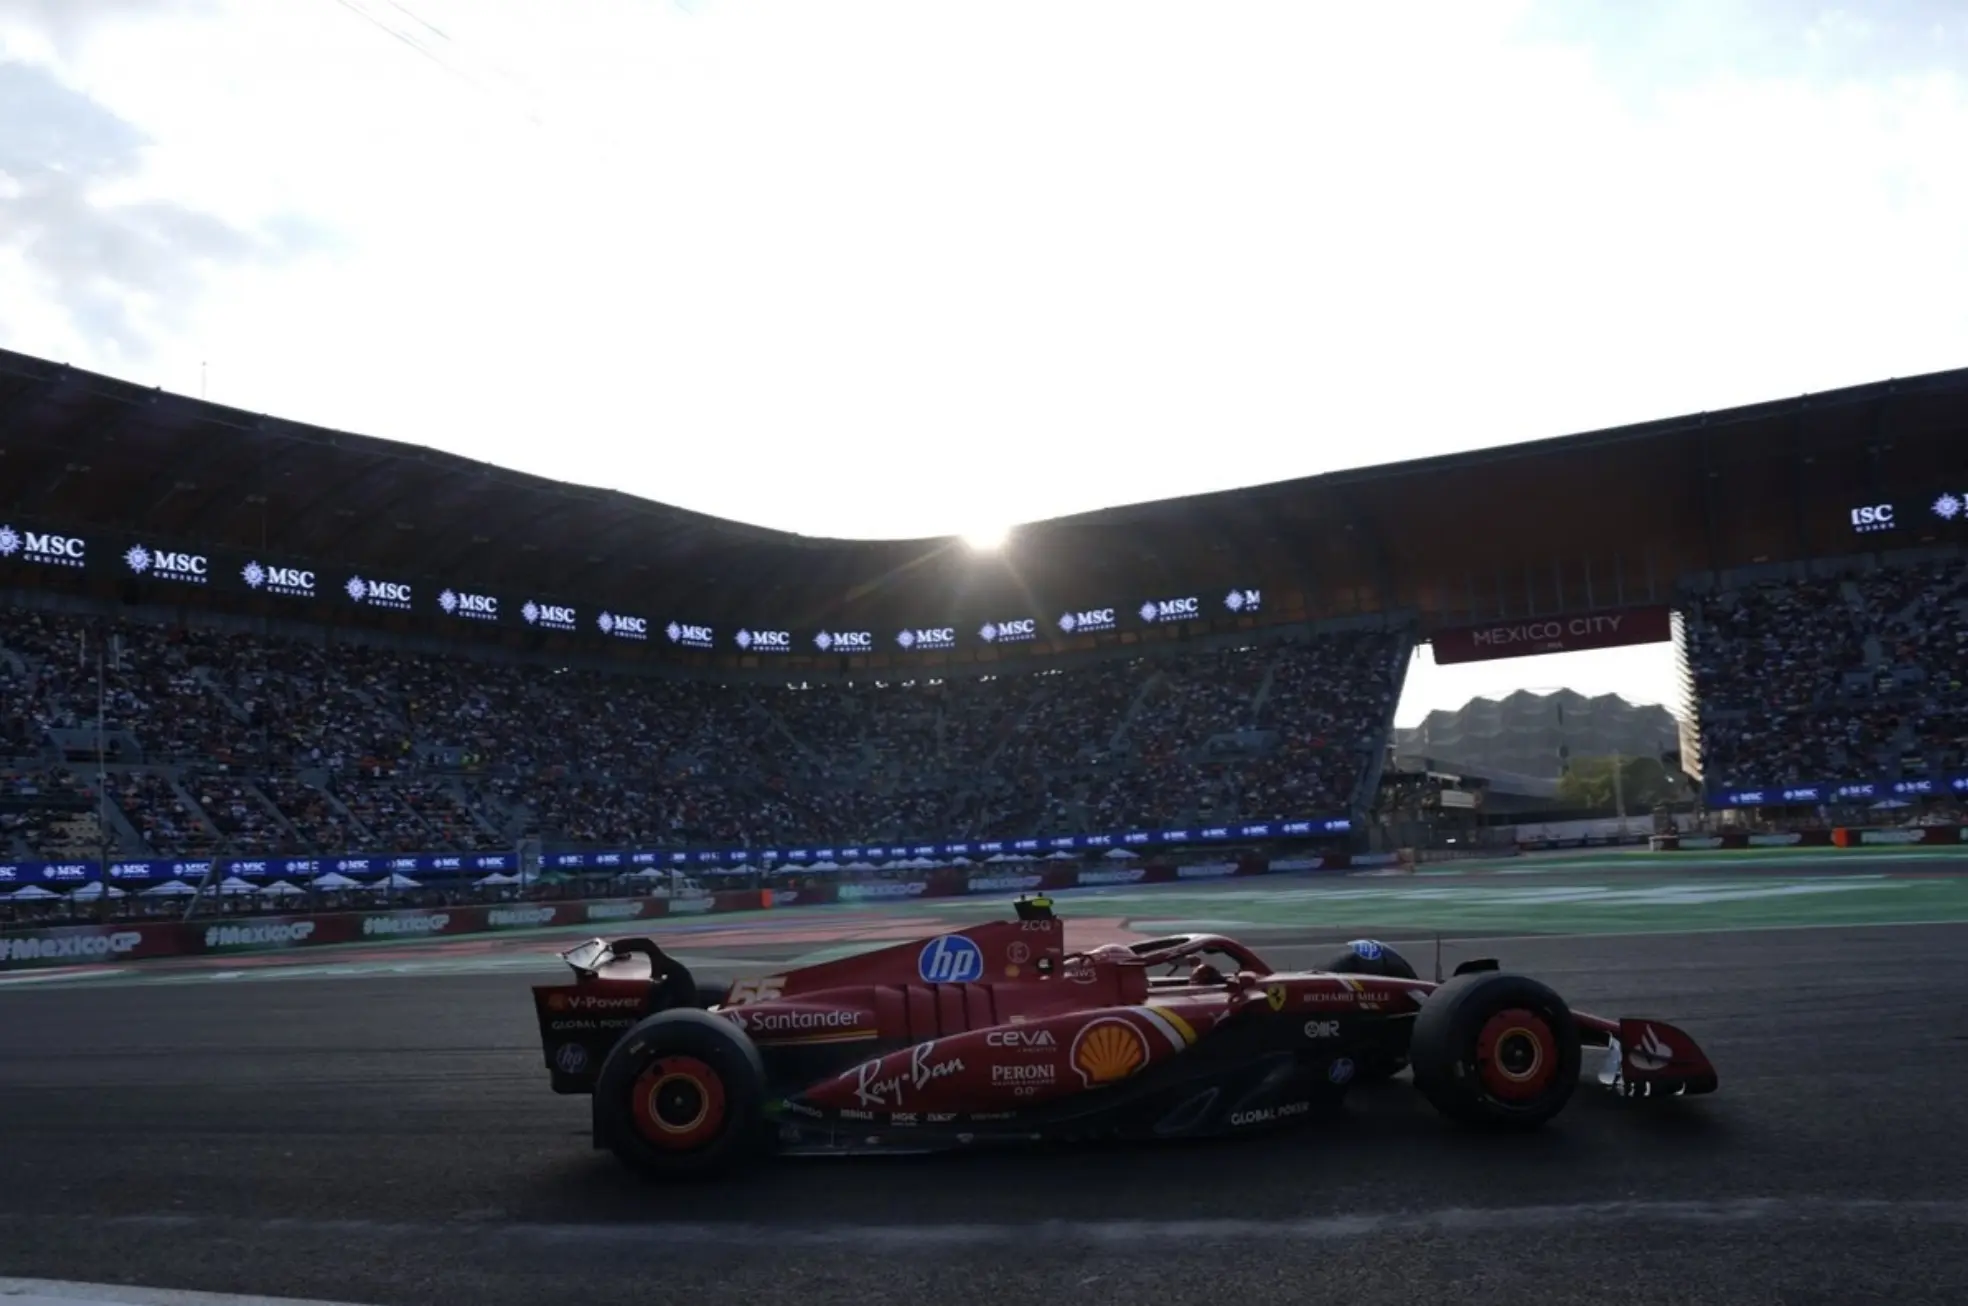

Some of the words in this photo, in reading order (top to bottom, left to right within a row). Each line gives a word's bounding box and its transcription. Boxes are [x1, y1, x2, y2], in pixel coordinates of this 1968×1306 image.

[24, 532, 85, 557] MSC
[24, 554, 85, 568] CRUISES
[154, 550, 207, 574] MSC
[267, 566, 316, 588] MSC
[367, 580, 411, 600] MSC
[459, 593, 498, 612] MSC
[1159, 598, 1197, 615] MSC
[539, 604, 576, 623] MSC
[1077, 608, 1114, 626] MSC
[614, 615, 647, 632] MSC
[998, 619, 1034, 635] MSC
[1473, 622, 1562, 646] MEXICO
[1570, 616, 1624, 636] CITY
[682, 625, 712, 641] MSC
[753, 631, 790, 645] MSC
[833, 632, 871, 645] MSC
[915, 628, 954, 643] MSC
[57, 866, 85, 877] MSC
[206, 921, 315, 946] #MexicoGP
[928, 936, 975, 982] hp
[568, 996, 641, 1009] V-Power
[551, 1019, 597, 1030] GLOBAL
[751, 1010, 861, 1032] Santander
[992, 1064, 1055, 1080] PERONI
[1231, 1107, 1276, 1126] GLOBAL
